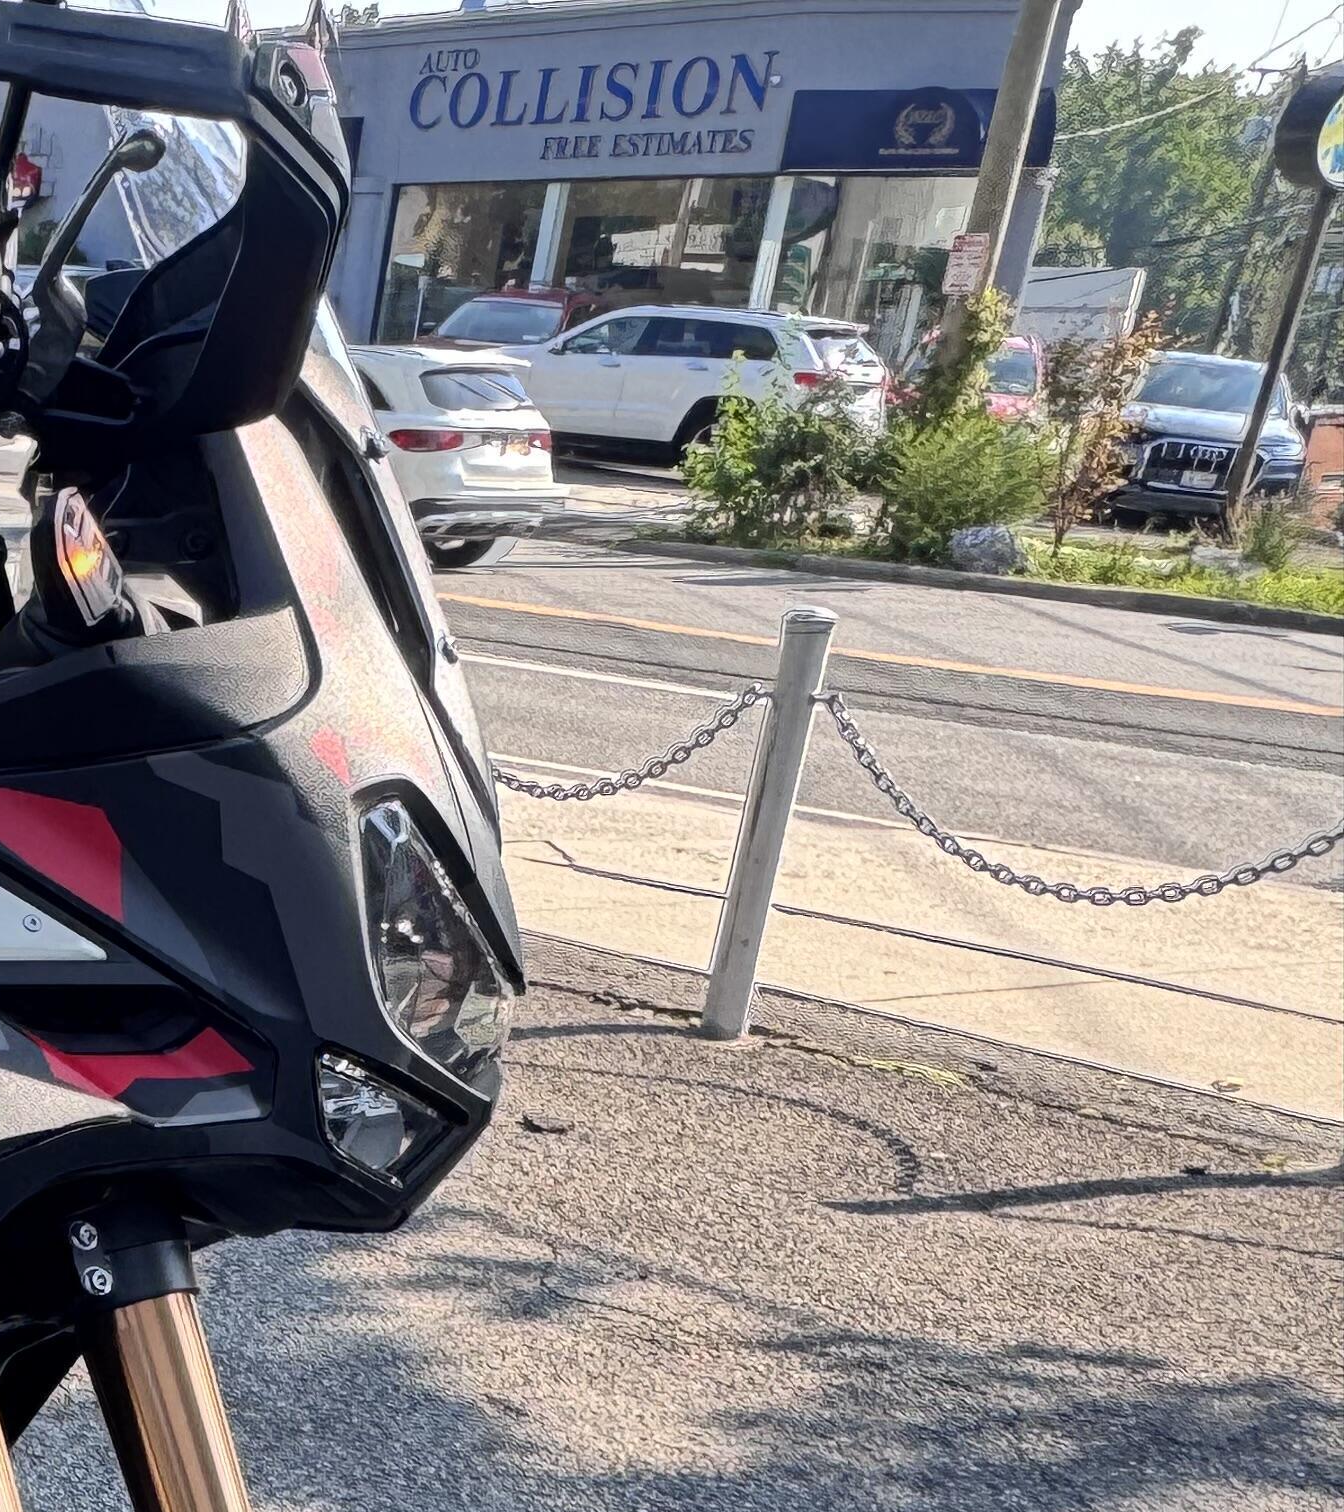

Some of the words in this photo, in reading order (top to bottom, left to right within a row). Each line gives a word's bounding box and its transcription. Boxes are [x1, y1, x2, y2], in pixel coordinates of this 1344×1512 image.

[419, 48, 480, 75] AUTO
[409, 51, 780, 131] COLLISION
[540, 136, 603, 160] FREE
[609, 129, 756, 158] ESTIMATES
